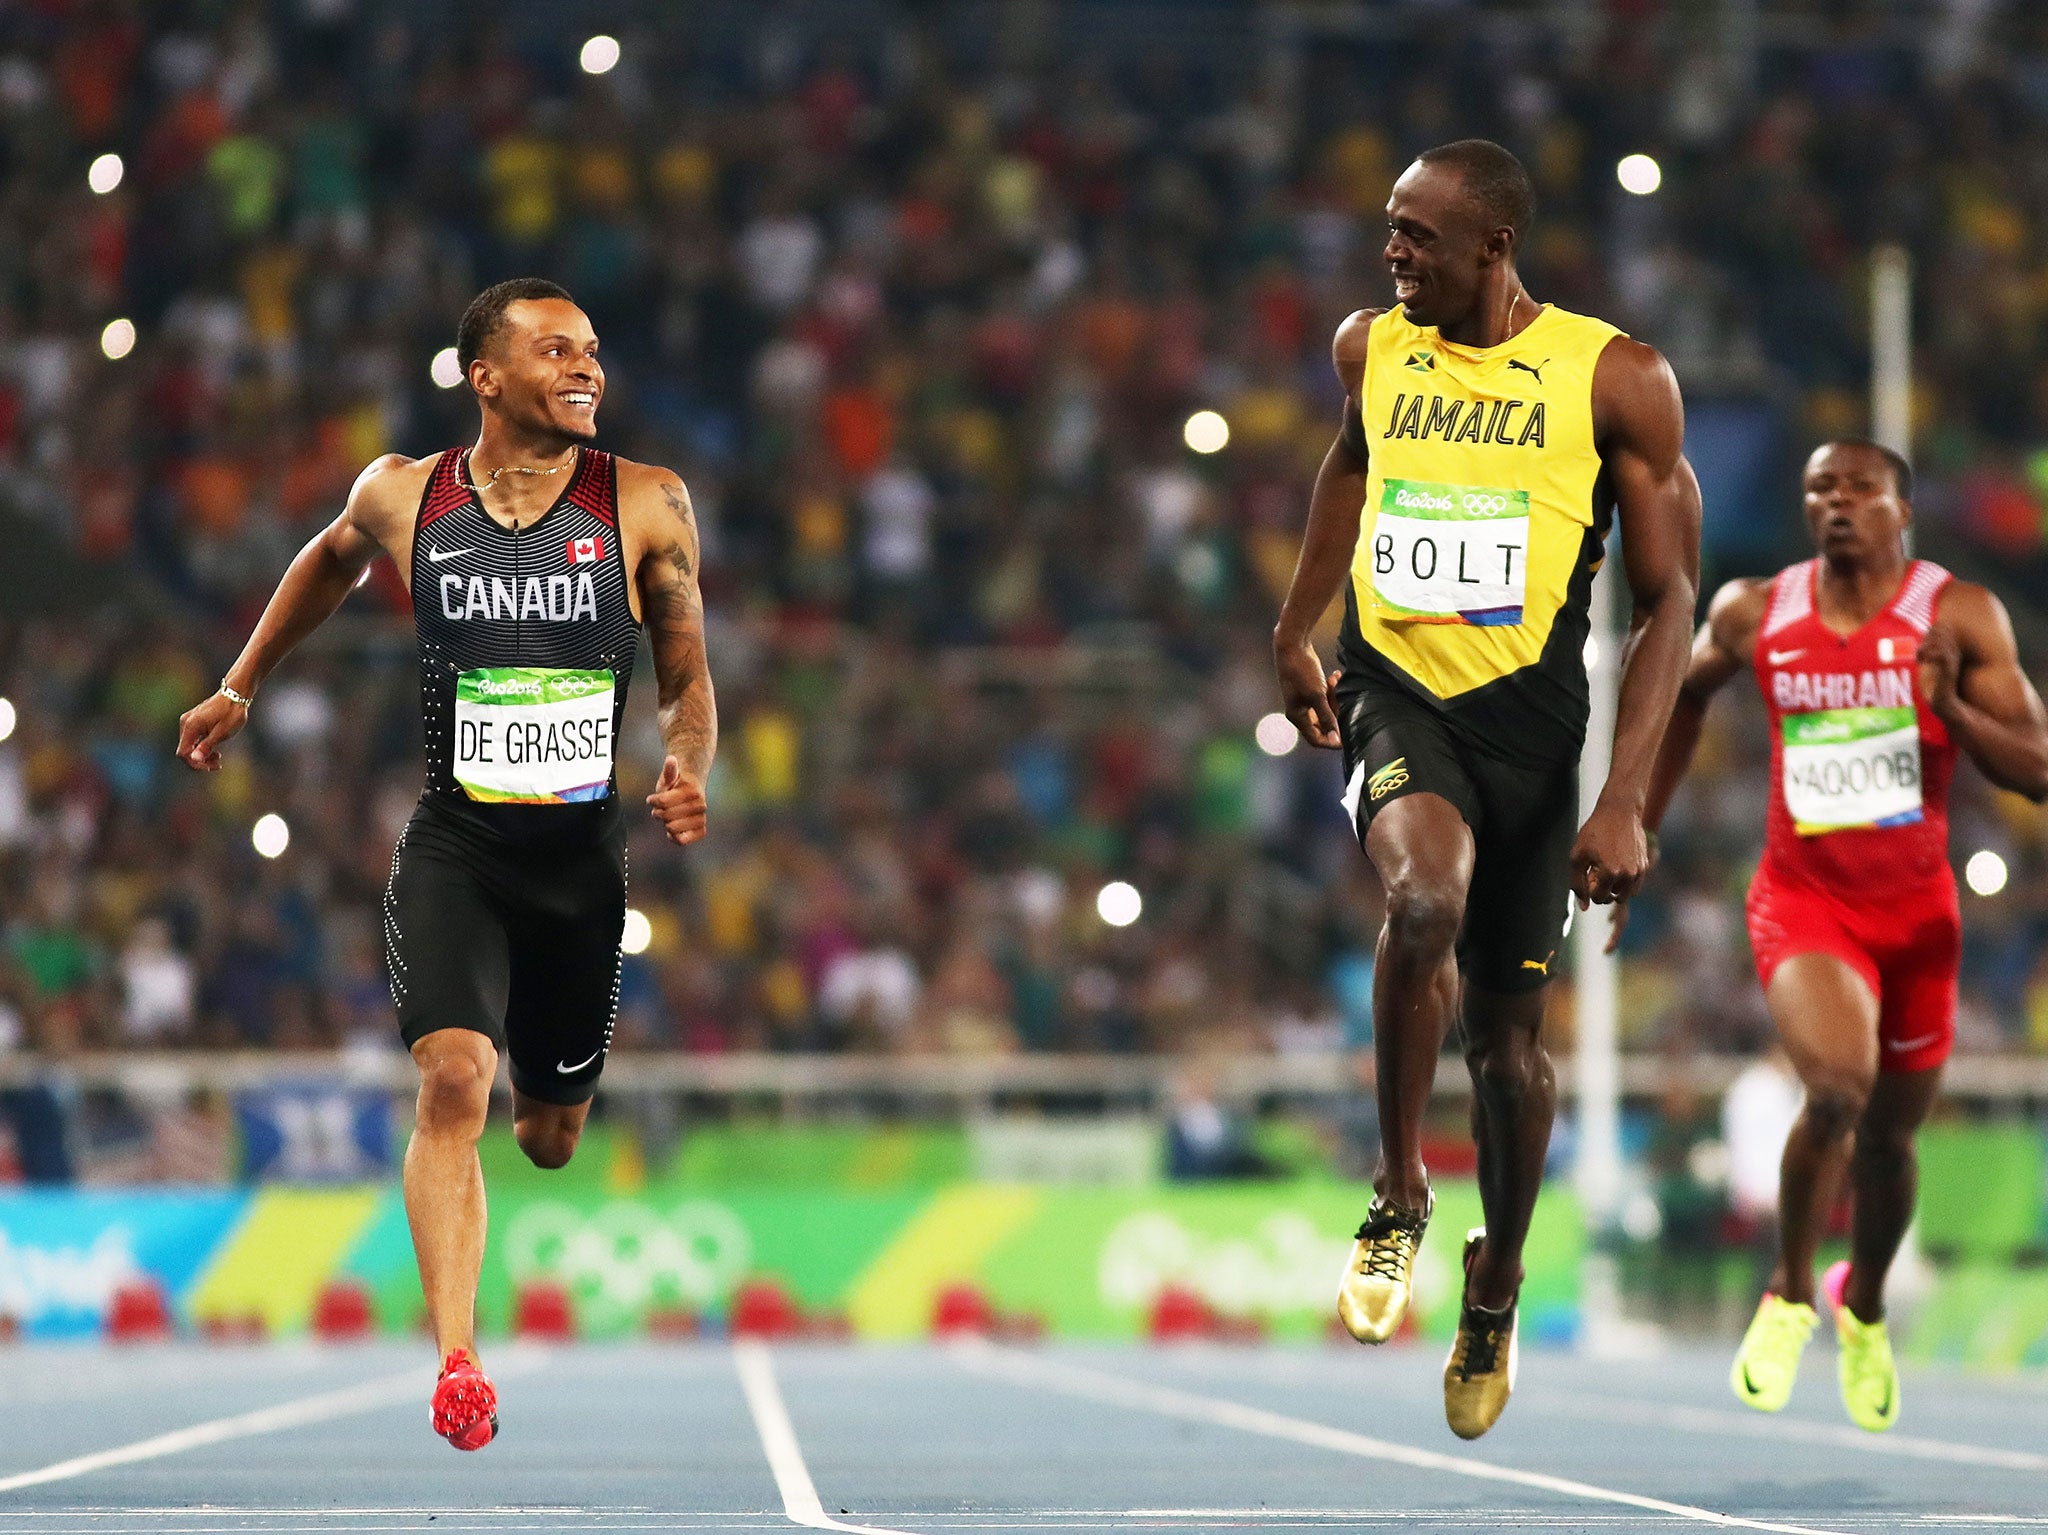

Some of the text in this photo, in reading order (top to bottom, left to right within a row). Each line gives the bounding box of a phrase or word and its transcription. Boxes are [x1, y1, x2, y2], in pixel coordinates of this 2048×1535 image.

[1384, 393, 1545, 448] JAMAICA
[1375, 533, 1522, 585] BOLT
[440, 572, 597, 621] CANADA
[1773, 667, 1912, 709] BAHRAIN
[460, 718, 609, 764] DE GRASSE
